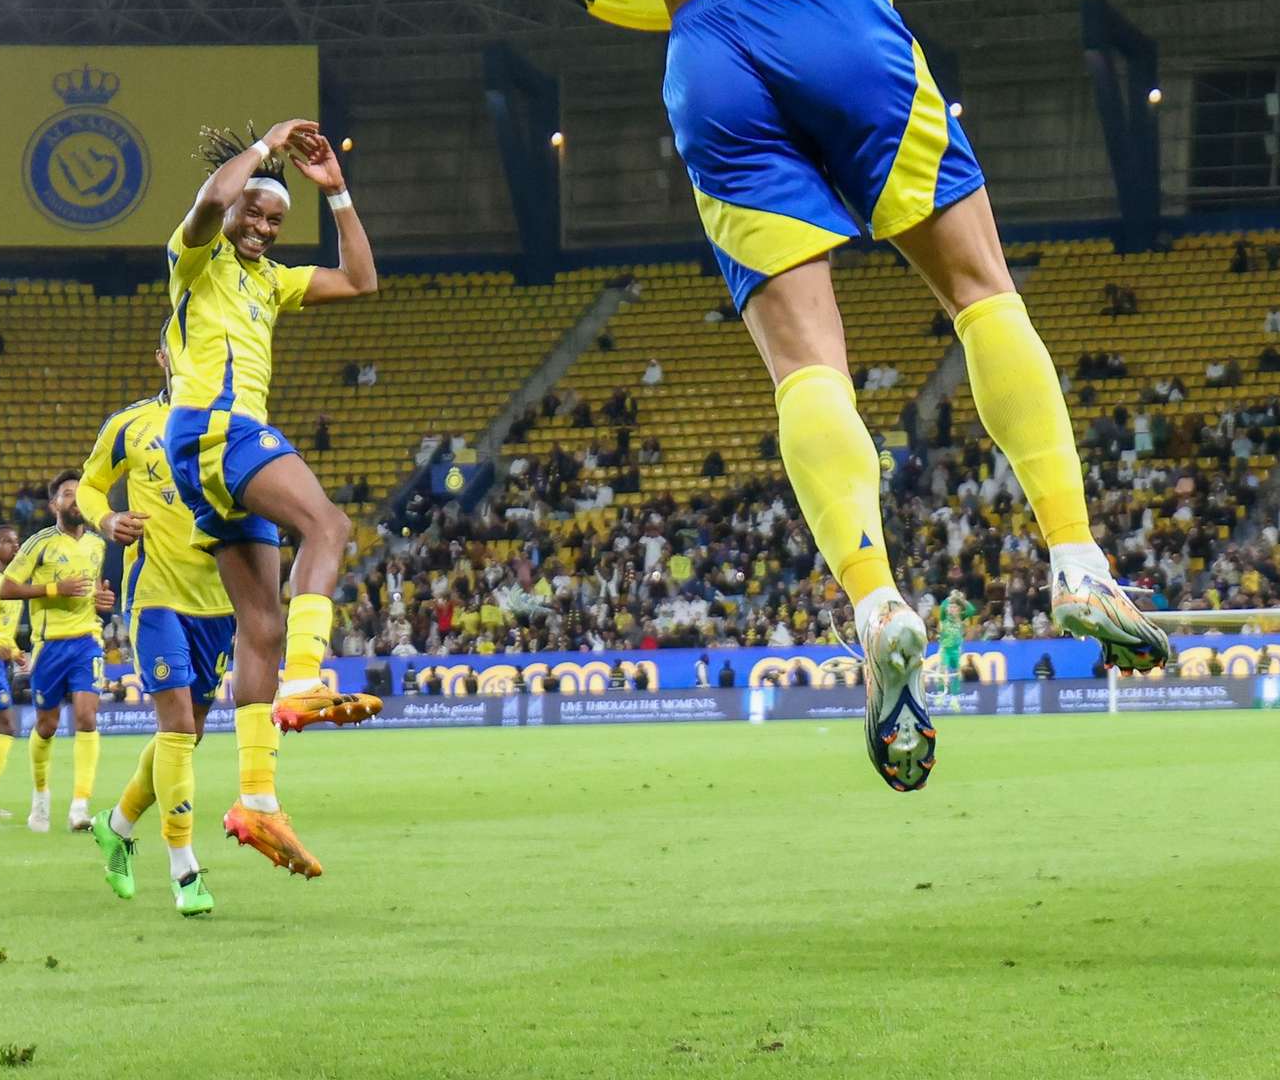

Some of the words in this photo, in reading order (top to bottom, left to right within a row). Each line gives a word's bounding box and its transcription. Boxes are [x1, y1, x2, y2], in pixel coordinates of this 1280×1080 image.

[1058, 688, 1084, 701] LIVE
[1145, 686, 1167, 699] THE
[1168, 685, 1227, 698] MOMENTS
[560, 700, 583, 713] LIVE
[585, 699, 639, 712] THROUGH
[639, 699, 660, 711] THE
[661, 697, 718, 711] MOMENTS
